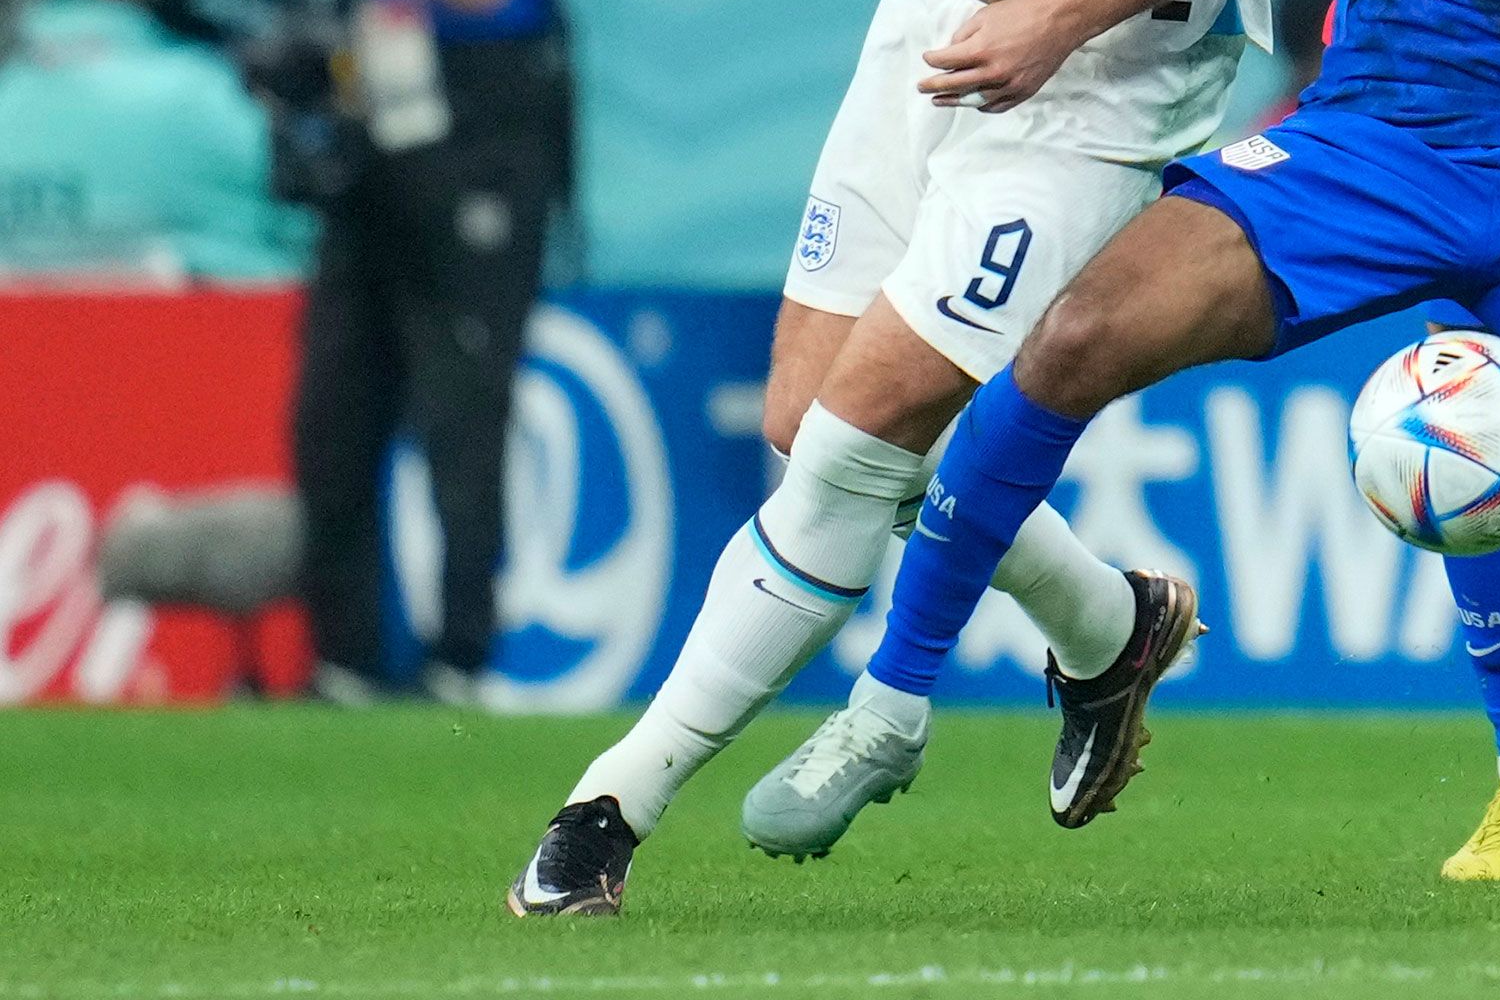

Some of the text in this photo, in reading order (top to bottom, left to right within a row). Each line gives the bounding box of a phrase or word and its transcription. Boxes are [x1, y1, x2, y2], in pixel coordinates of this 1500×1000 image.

[1247, 137, 1284, 160] USA
[963, 218, 1033, 310] 9
[926, 473, 957, 520] USA
